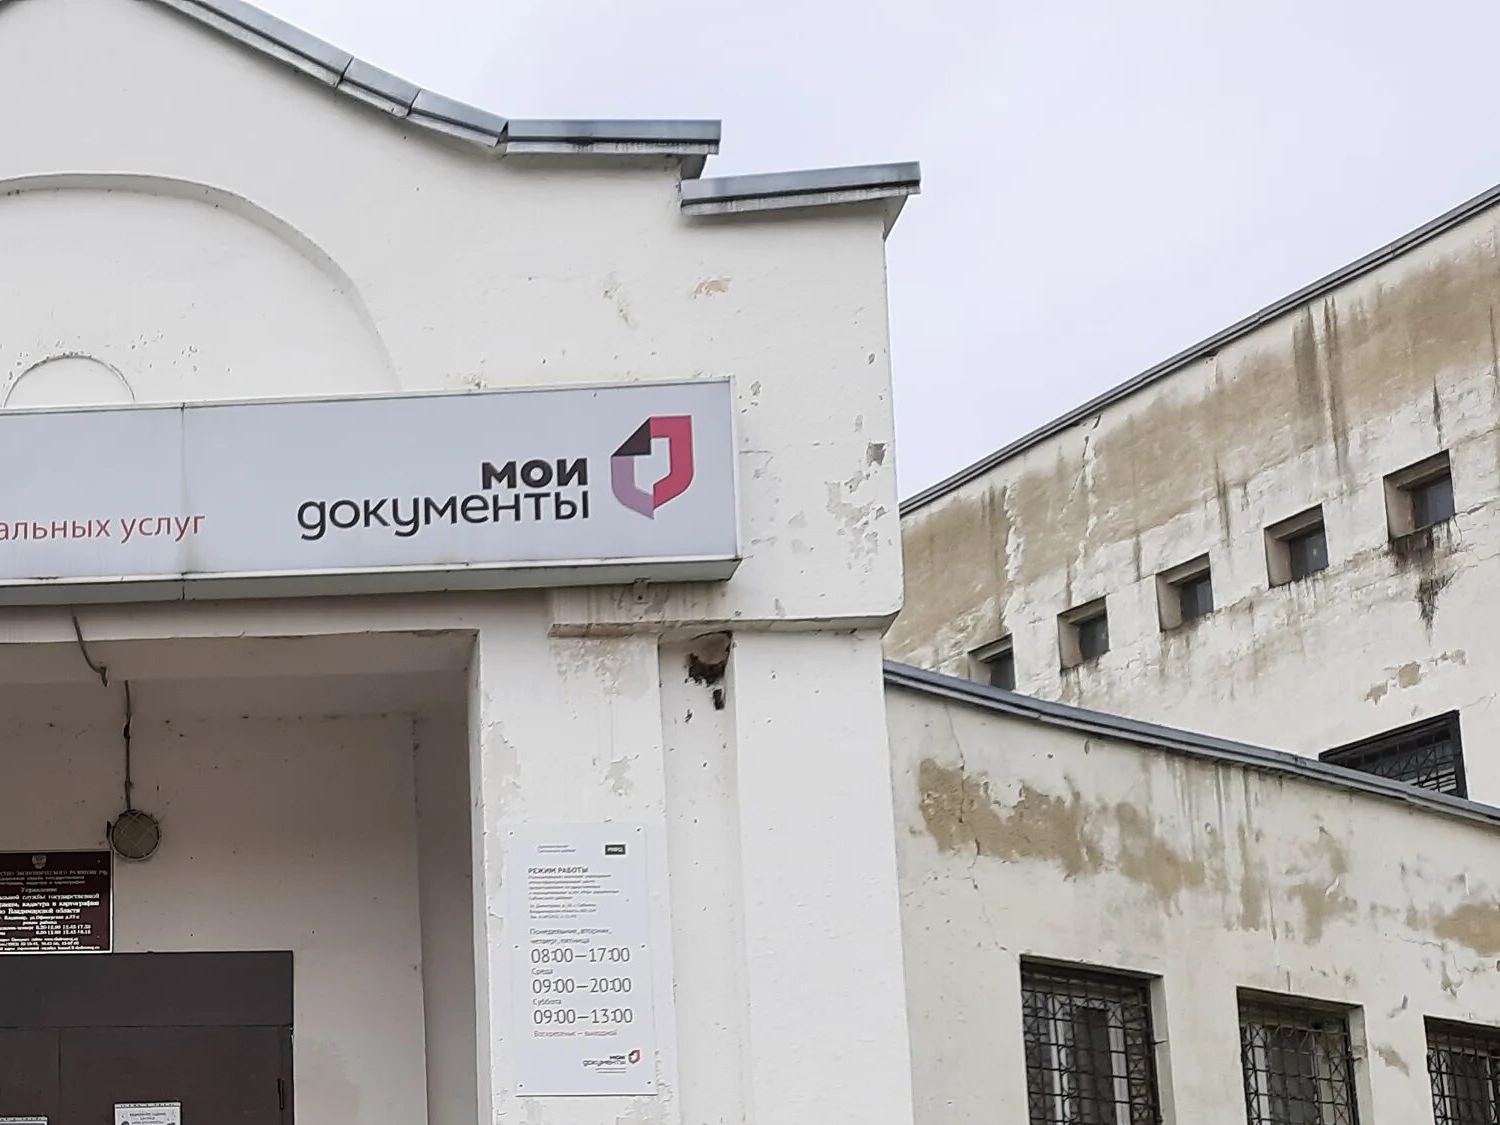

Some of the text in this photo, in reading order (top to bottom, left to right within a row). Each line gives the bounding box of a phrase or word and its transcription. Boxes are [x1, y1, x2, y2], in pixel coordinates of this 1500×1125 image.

[481, 457, 589, 490] мои
[120, 514, 206, 543] услуг
[297, 490, 590, 541] документы
